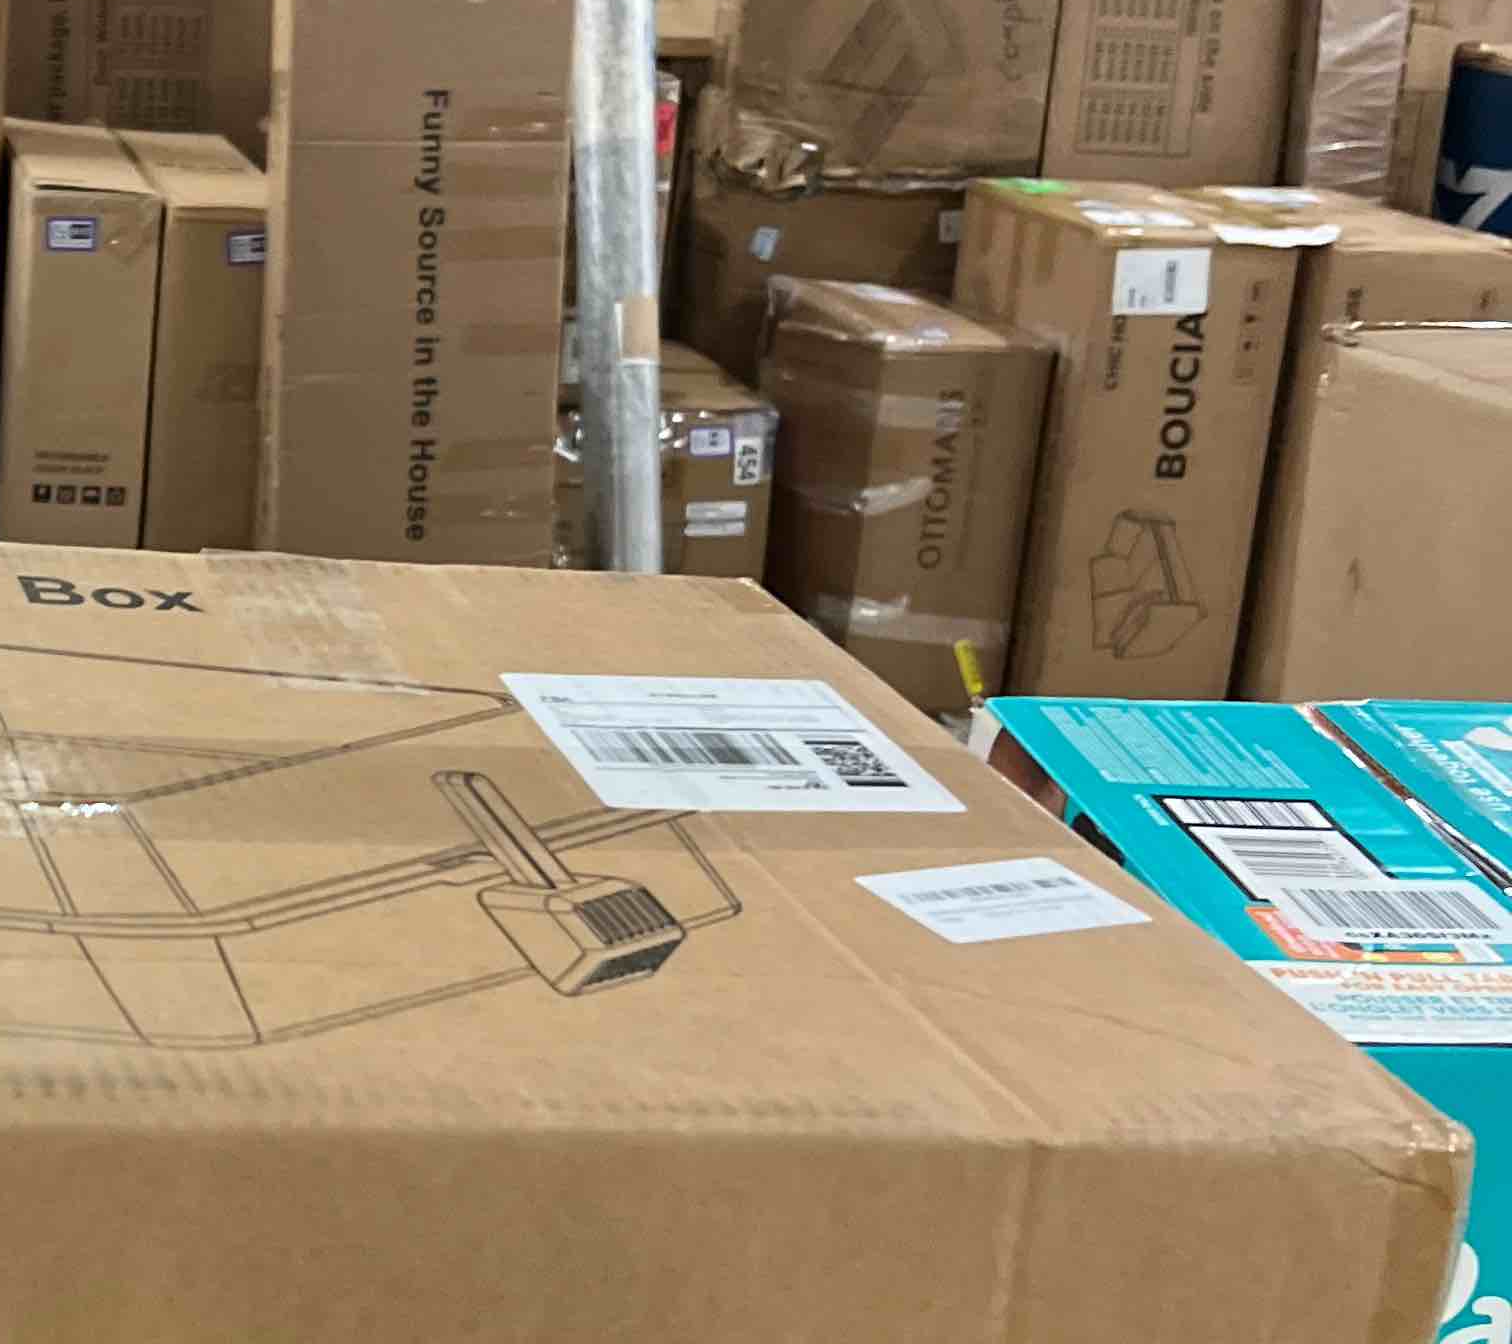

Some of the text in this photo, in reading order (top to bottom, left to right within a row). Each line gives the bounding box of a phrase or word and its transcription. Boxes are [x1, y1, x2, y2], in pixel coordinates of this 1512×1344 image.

[405, 88, 450, 542] Funny Source in the House
[1154, 311, 1209, 480] BOUCIA
[18, 575, 205, 613] Box
